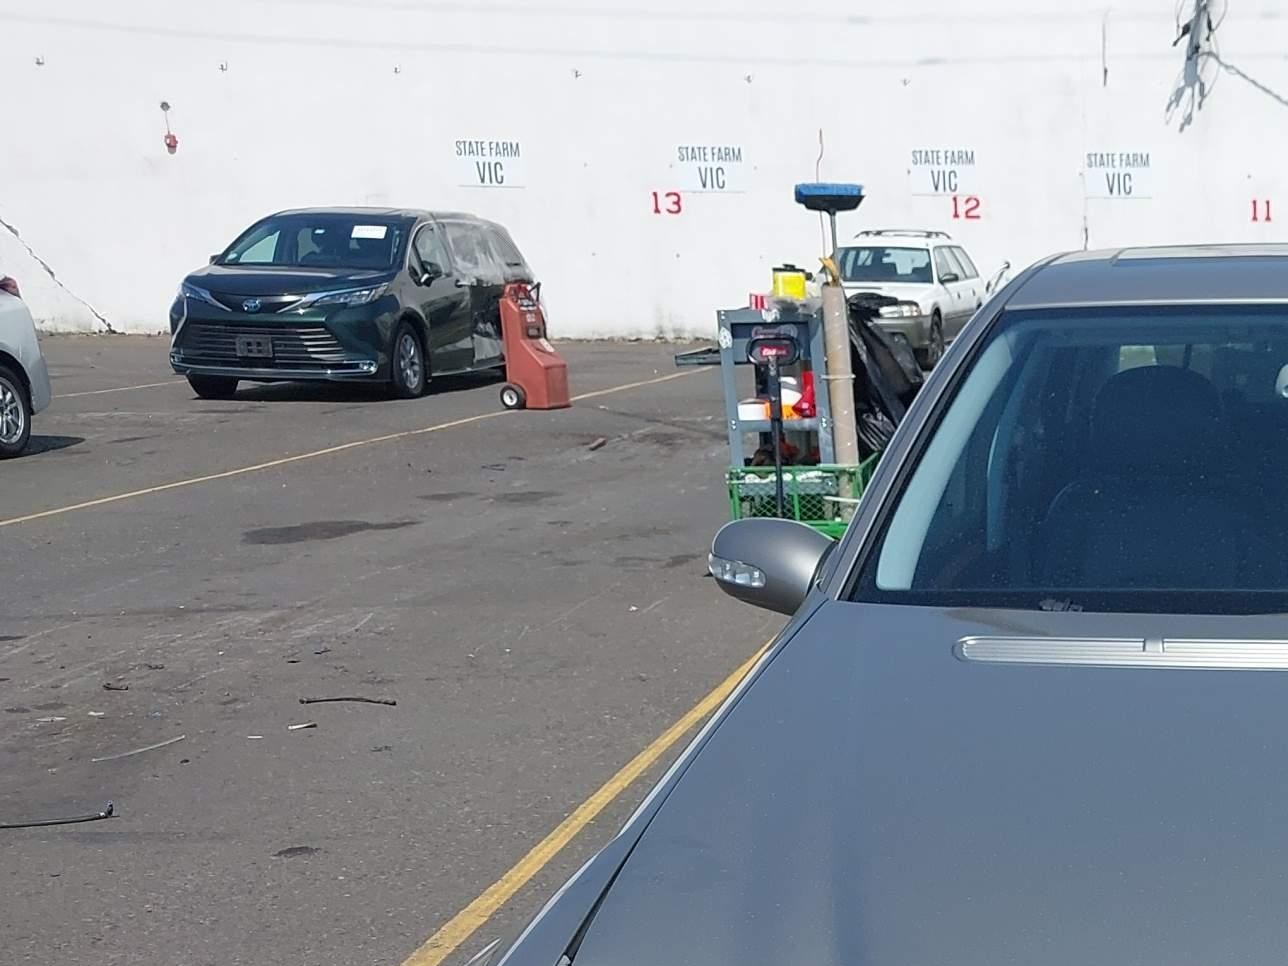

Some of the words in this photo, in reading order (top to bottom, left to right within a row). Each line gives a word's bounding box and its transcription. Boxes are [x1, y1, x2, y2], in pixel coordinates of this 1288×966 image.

[455, 140, 487, 157] STATE
[489, 141, 520, 158] FARM
[678, 146, 708, 162] STATE
[711, 147, 742, 163] FARM
[912, 149, 942, 166] STATE
[944, 150, 975, 167] FARM
[1086, 152, 1117, 168] STATE
[1119, 152, 1150, 169] FARM
[475, 161, 504, 185] VIC
[698, 166, 726, 190] VIC
[930, 170, 958, 193] VIC
[1105, 172, 1133, 196] VIC
[652, 191, 683, 215] 13
[951, 196, 981, 220] 12
[1251, 199, 1272, 223] 11
